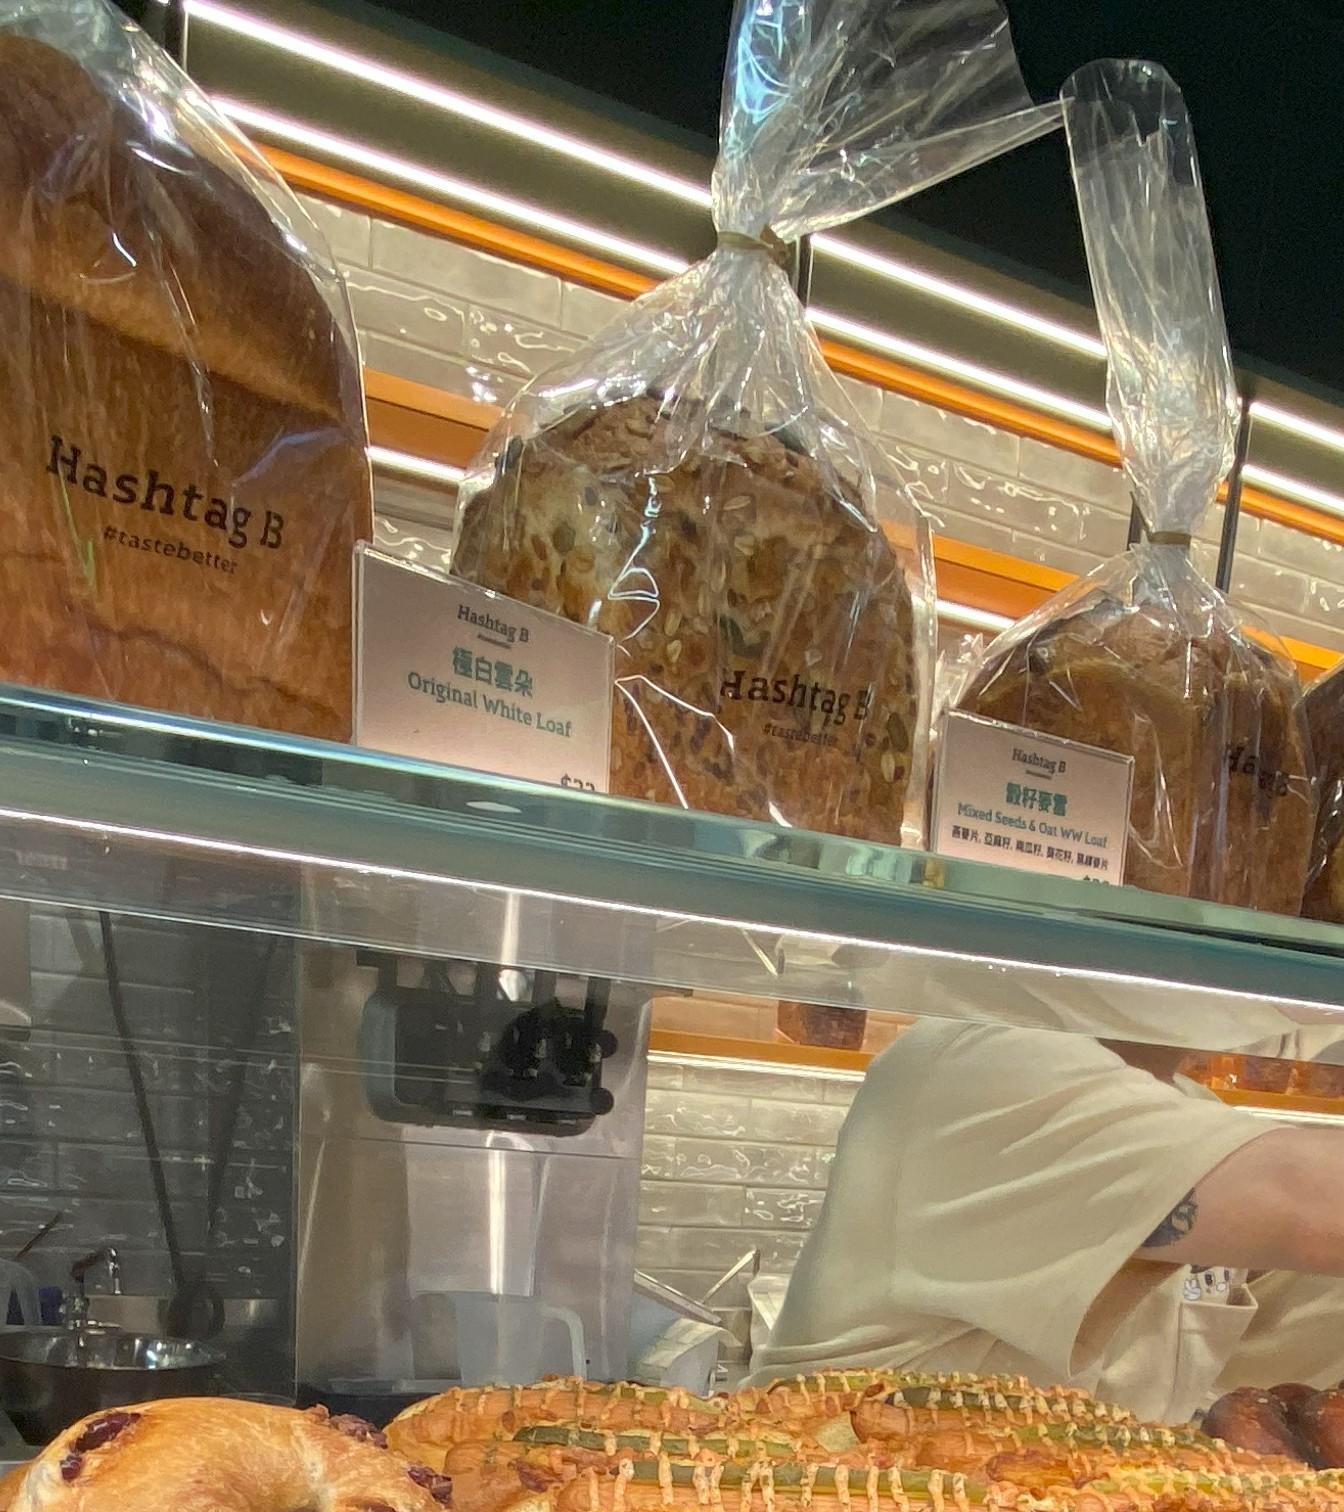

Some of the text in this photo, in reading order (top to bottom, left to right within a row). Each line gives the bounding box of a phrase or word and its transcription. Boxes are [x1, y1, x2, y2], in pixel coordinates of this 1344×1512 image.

[46, 435, 284, 549] Hashtag B
[103, 524, 238, 575] #tastebetter
[458, 605, 516, 643] Hashtag
[519, 627, 530, 643] B
[408, 671, 572, 738] Original White Loaf
[720, 670, 851, 725] Hashtag
[1012, 748, 1066, 774] Hashtag B
[958, 803, 992, 822] Mixed
[995, 811, 1027, 830] Seeds
[1039, 821, 1057, 836] Oat
[1085, 831, 1109, 848] Loaf
